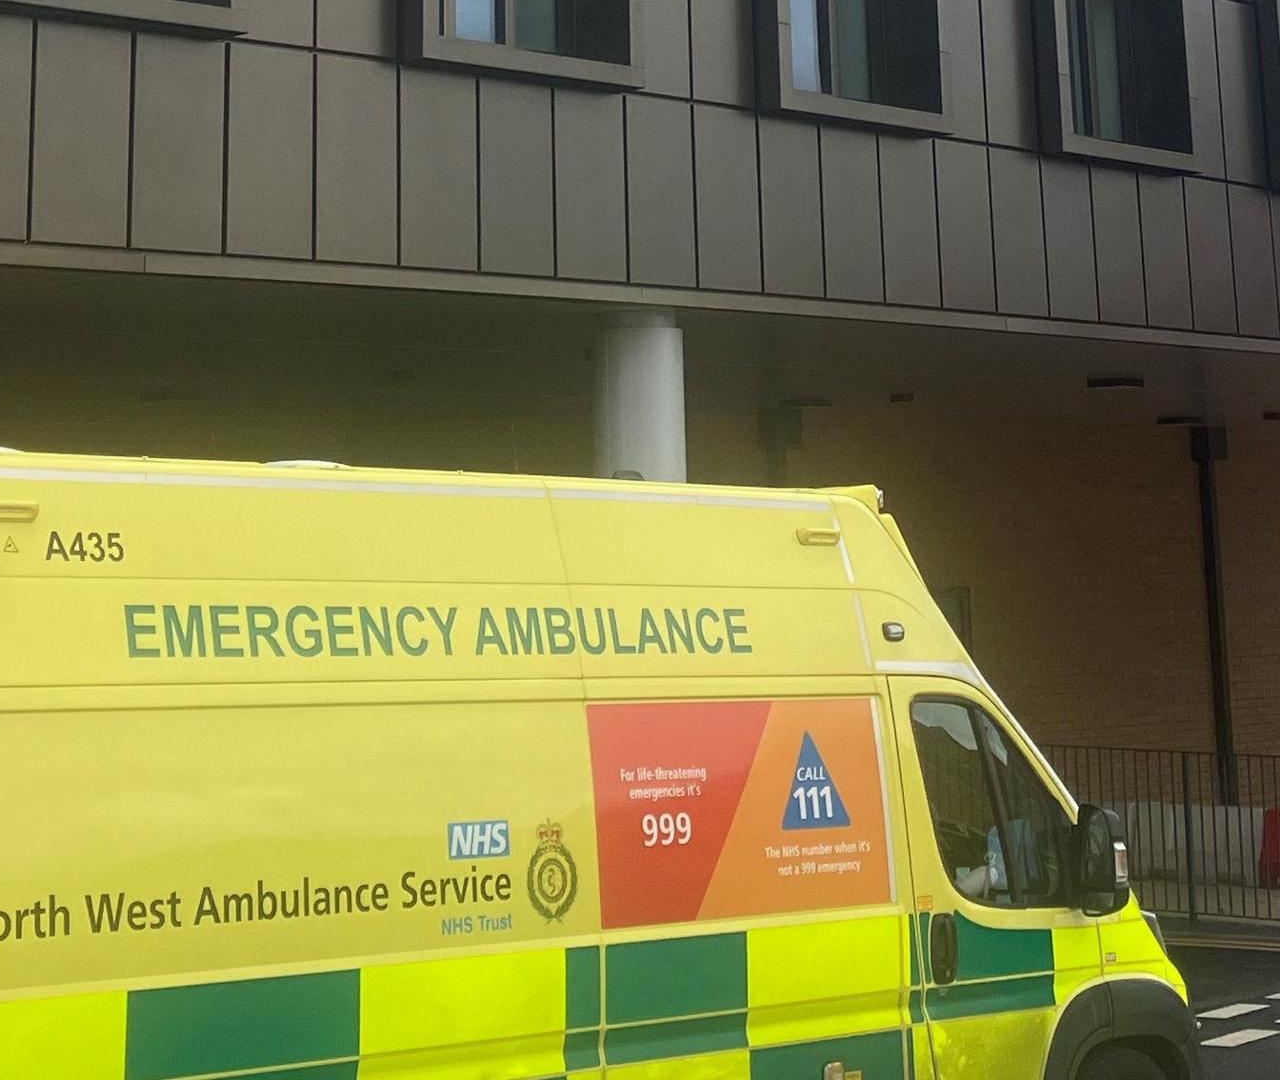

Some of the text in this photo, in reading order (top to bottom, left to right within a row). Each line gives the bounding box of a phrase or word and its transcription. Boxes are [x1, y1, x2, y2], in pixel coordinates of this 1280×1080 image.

[45, 530, 124, 562] A435
[124, 604, 753, 659] EMERGENCY AMBULANCE
[620, 765, 707, 782] For life-threatening
[796, 766, 827, 782] CALL
[629, 783, 701, 802] emergencies it's
[792, 785, 834, 820] 111
[450, 821, 508, 857] NHS
[641, 812, 692, 848] 999
[764, 840, 871, 859] The NHS number when it's
[778, 859, 862, 876] not a 999 emergency
[85, 889, 182, 935] West
[193, 877, 389, 926] Ambulance
[401, 865, 512, 909] Service
[441, 914, 513, 936] NHS Trust
